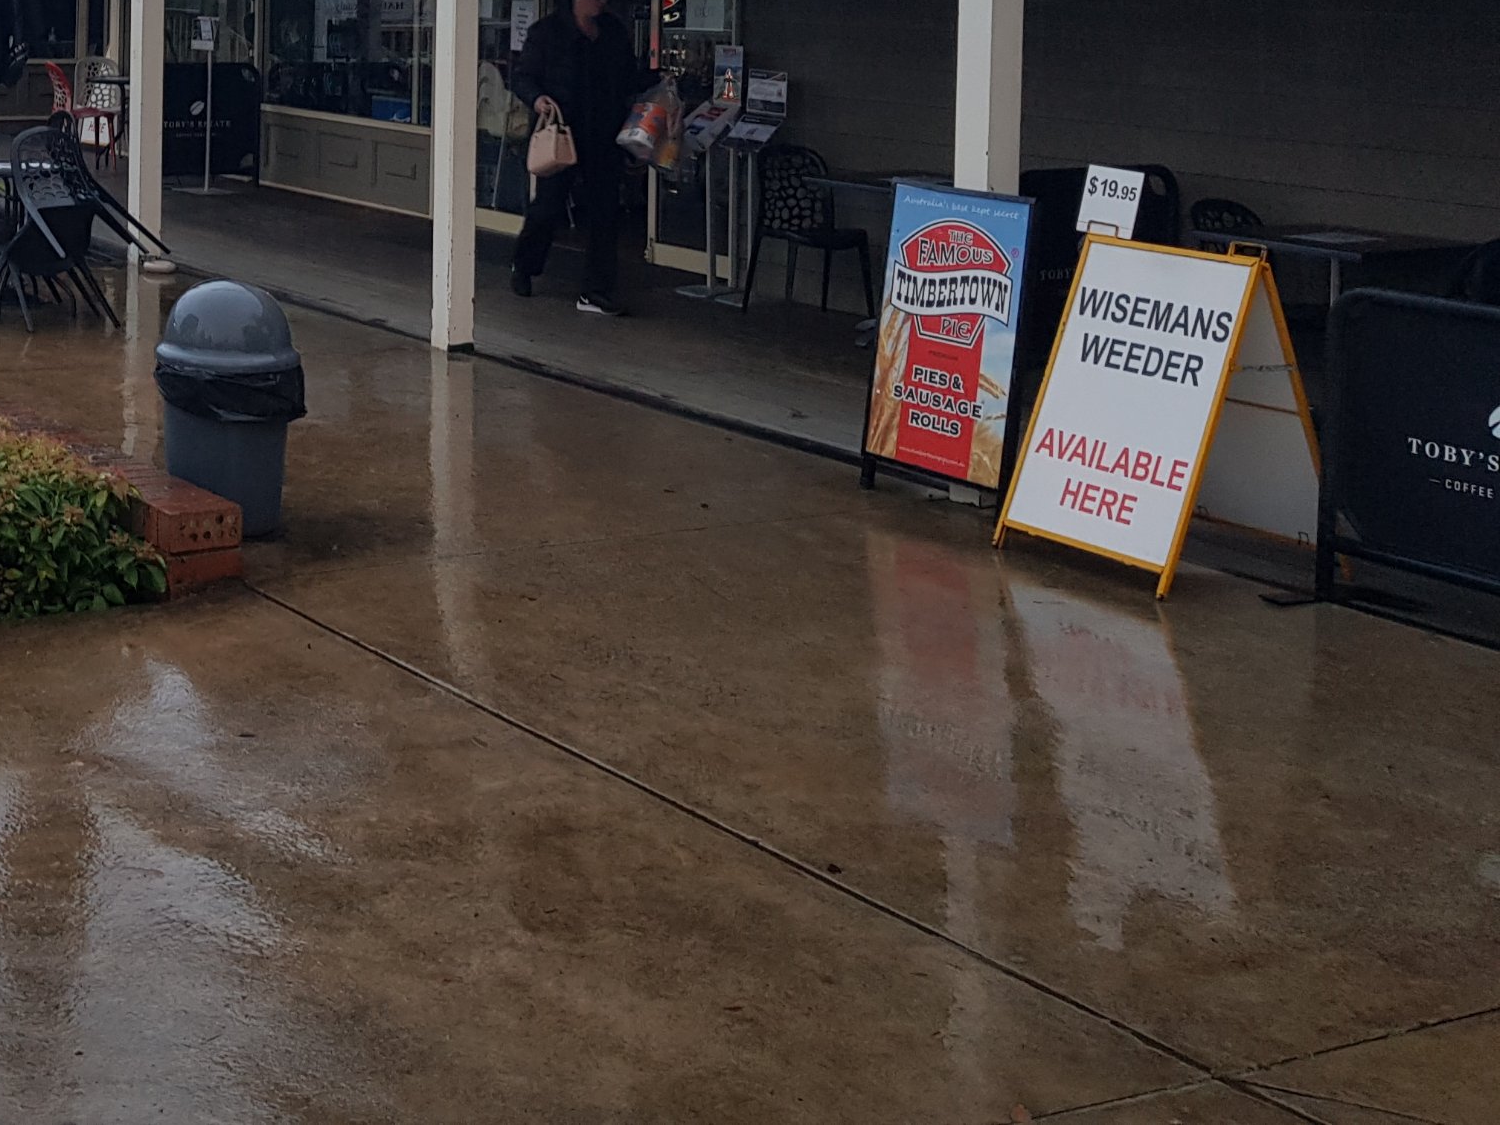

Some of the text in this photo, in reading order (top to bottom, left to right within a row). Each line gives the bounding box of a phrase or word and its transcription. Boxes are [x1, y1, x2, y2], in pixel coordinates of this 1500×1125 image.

[1087, 175, 1138, 202] $19.95
[903, 195, 949, 210] Australia's
[952, 203, 968, 212] best
[971, 205, 991, 216] kept
[917, 237, 995, 266] FAMOUS
[948, 229, 974, 246] THE
[896, 269, 1009, 315] TIMBERTOWN
[940, 316, 971, 340] PIE
[1078, 286, 1233, 343] WISEMANS
[1080, 332, 1204, 387] WEEDER
[912, 365, 964, 392] PIES &
[893, 384, 982, 419] SAUSAGE
[909, 410, 960, 436] ROLLS
[1034, 427, 1189, 492] AVAILABLE
[1407, 437, 1500, 473] TOBY'S
[1059, 477, 1138, 526] HERE
[1445, 478, 1495, 500] COFFEE
